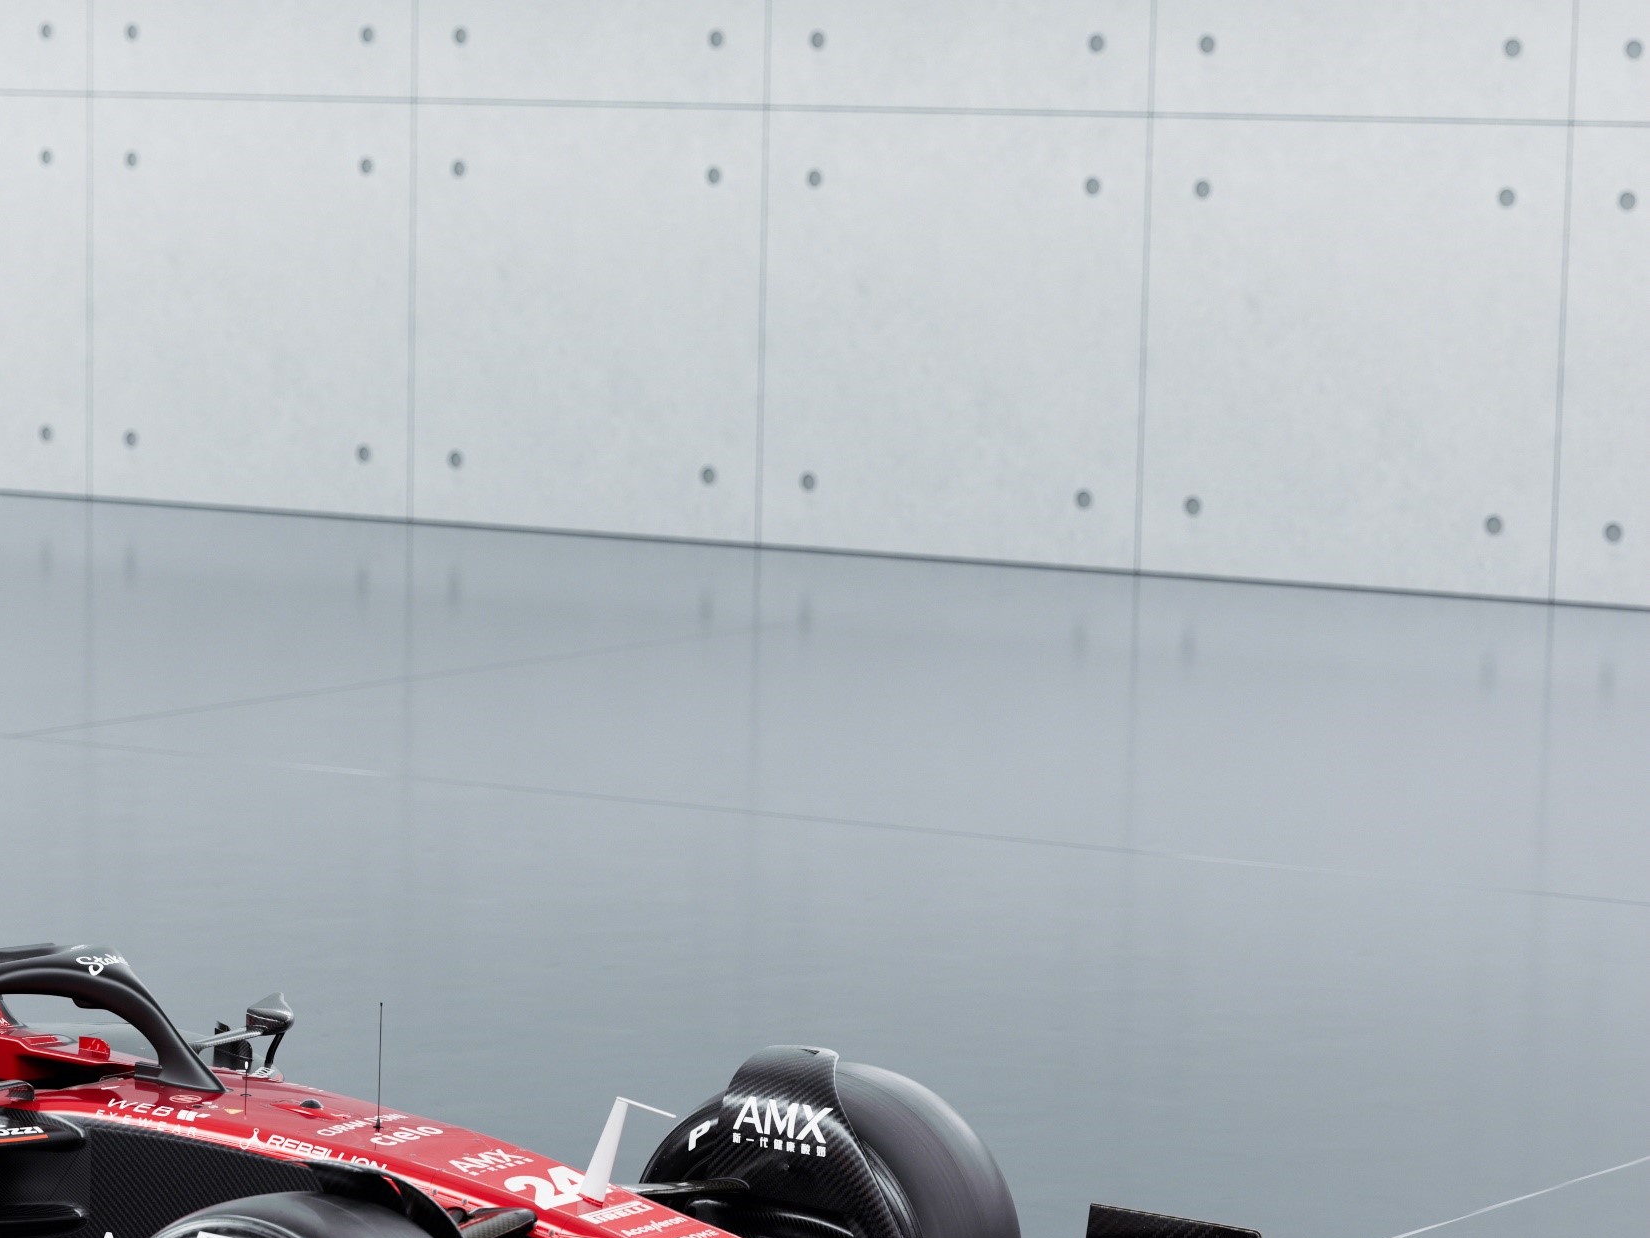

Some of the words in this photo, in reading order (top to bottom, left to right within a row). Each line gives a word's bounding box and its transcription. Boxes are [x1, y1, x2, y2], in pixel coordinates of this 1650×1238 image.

[107, 1098, 175, 1117] WEB
[732, 1096, 834, 1144] AMX
[370, 1125, 444, 1147] cielo
[448, 1148, 525, 1173] AMX
[504, 1166, 613, 1211] 24
[578, 1200, 654, 1225] PIRELLI
